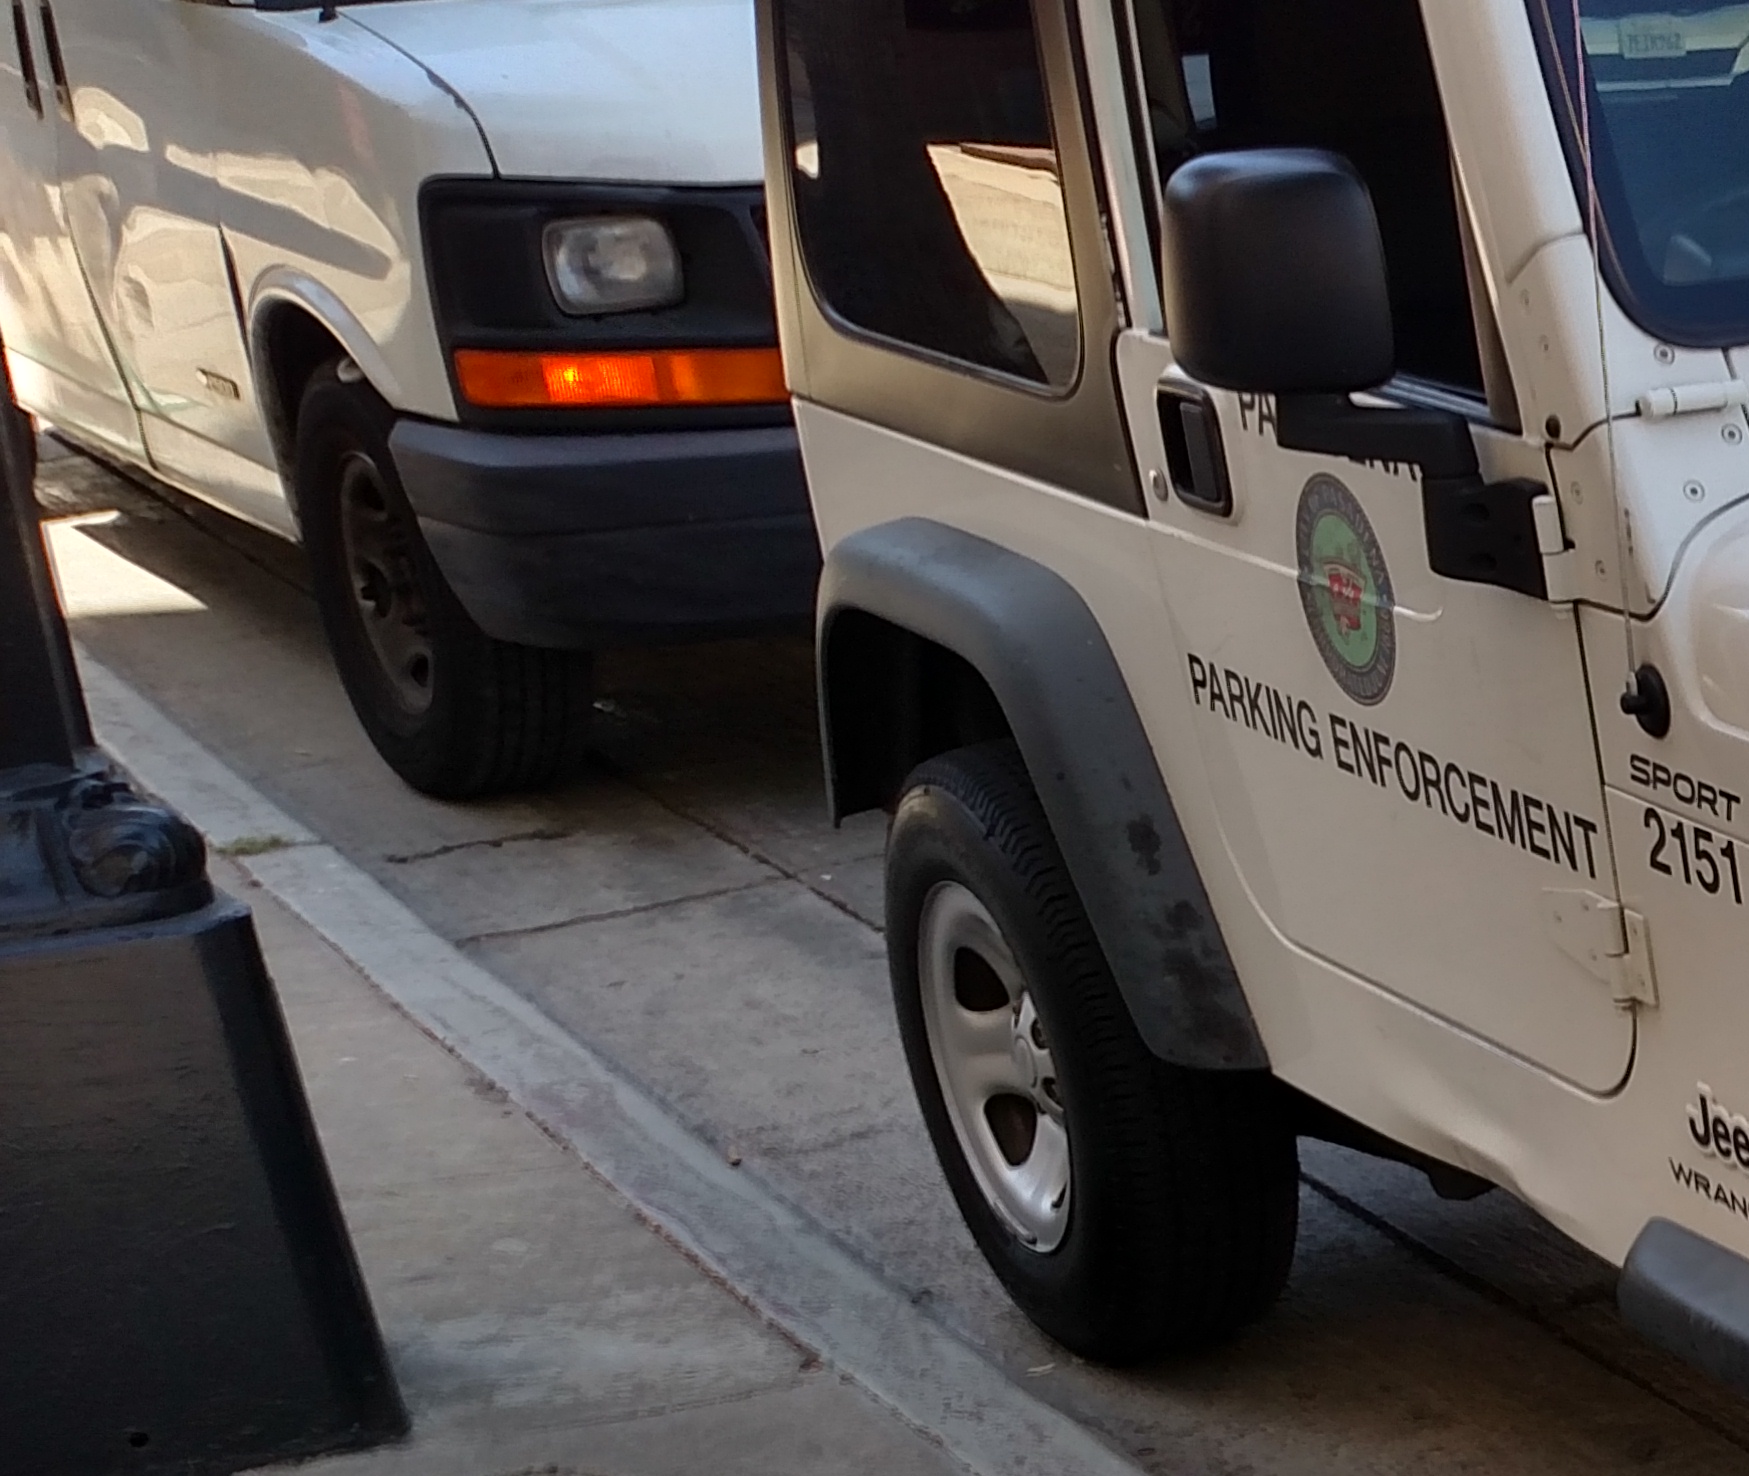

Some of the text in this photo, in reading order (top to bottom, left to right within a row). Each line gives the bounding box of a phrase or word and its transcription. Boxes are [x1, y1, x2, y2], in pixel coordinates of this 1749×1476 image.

[1187, 652, 1323, 760] PARKING
[1328, 712, 1598, 879] ENFORCEMENT
[1629, 753, 1742, 822] SPORT
[1643, 807, 1743, 905] 2151
